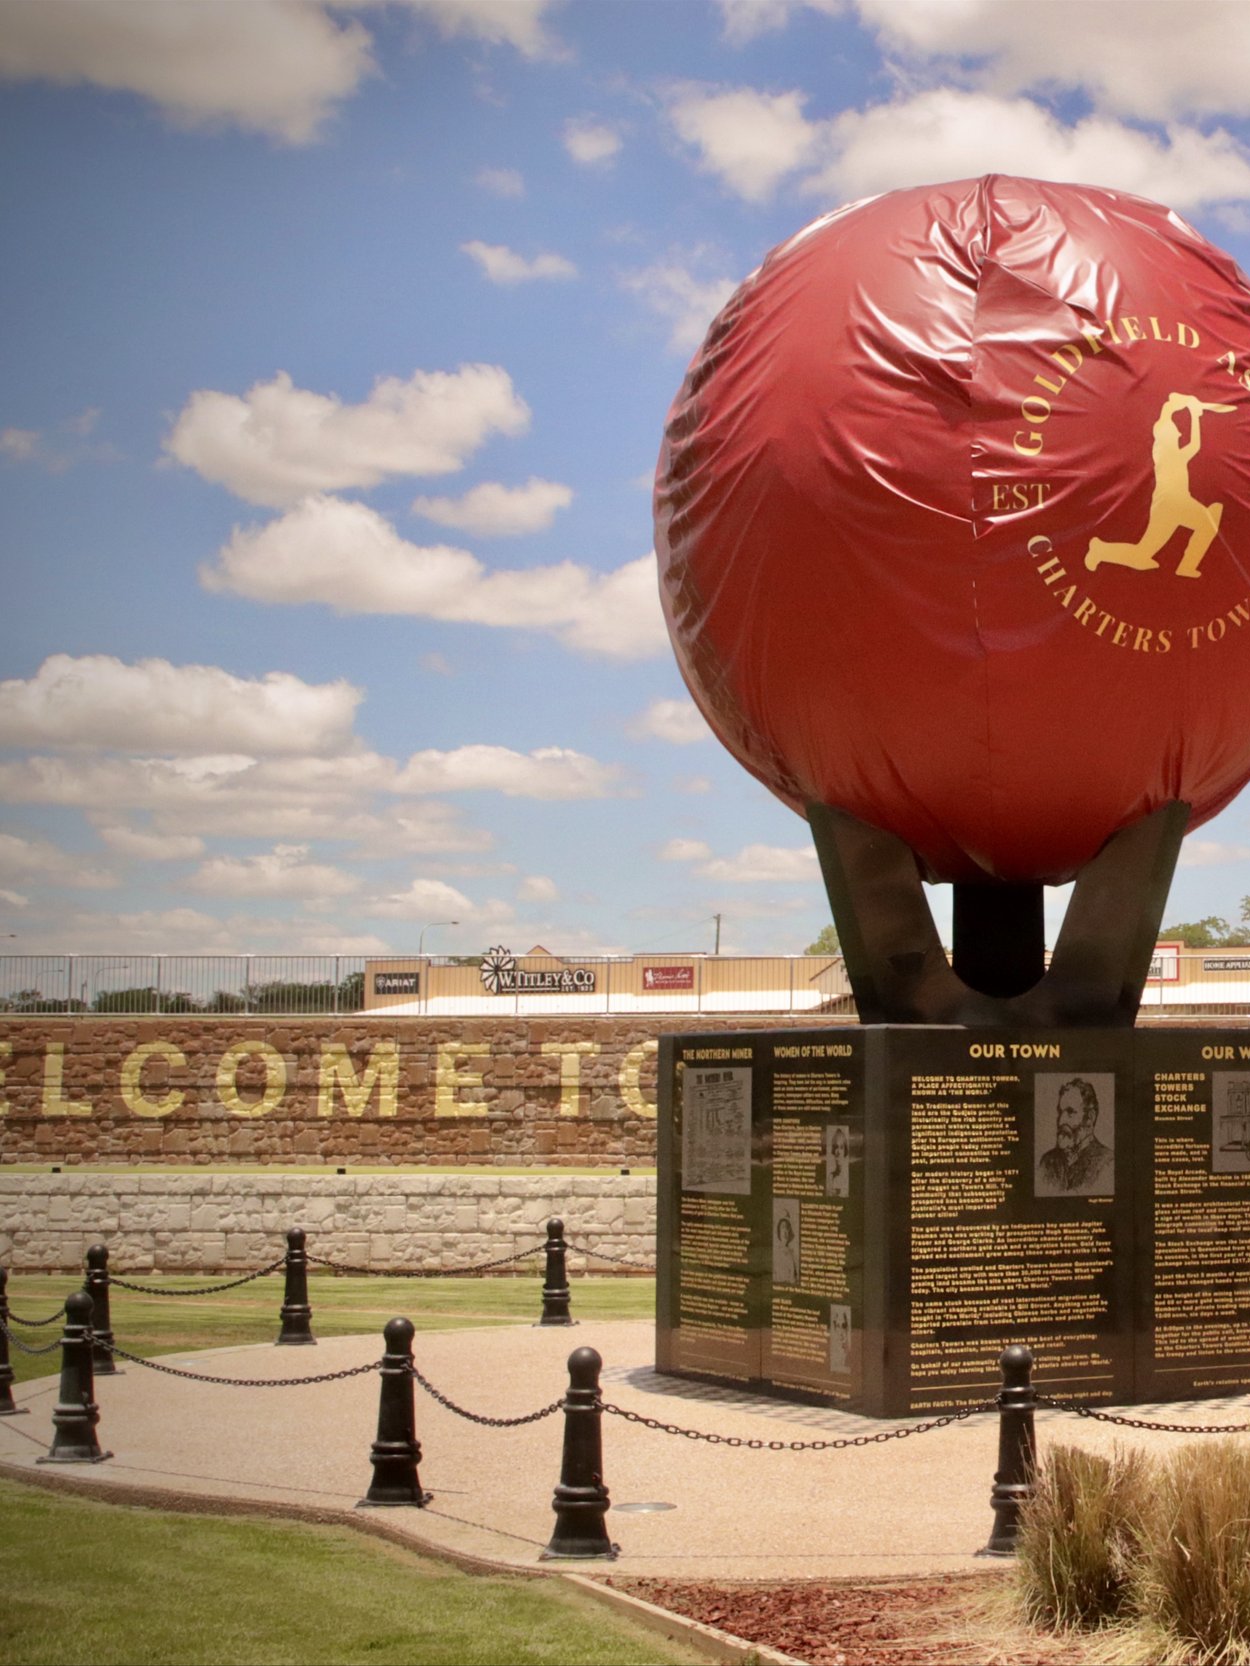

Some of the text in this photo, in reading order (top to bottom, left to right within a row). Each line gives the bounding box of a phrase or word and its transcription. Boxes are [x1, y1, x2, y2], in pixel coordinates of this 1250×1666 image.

[992, 483, 1050, 510] EST
[1027, 535, 1172, 653] CHARTERS
[384, 978, 416, 988] ARIAT
[683, 1047, 753, 1060] THE NORTHERN MINER
[774, 1045, 852, 1058] WOMEN OF THE WORLD
[969, 1044, 1061, 1059] OUR TOWN
[1201, 1046, 1234, 1060] OUR
[0, 1041, 490, 1118] LCOME
[1154, 1073, 1205, 1081] CHARTERS
[1154, 1084, 1194, 1092] TOWERS
[1154, 1094, 1187, 1102] STOCK
[1154, 1104, 1206, 1113] EXCHANGE
